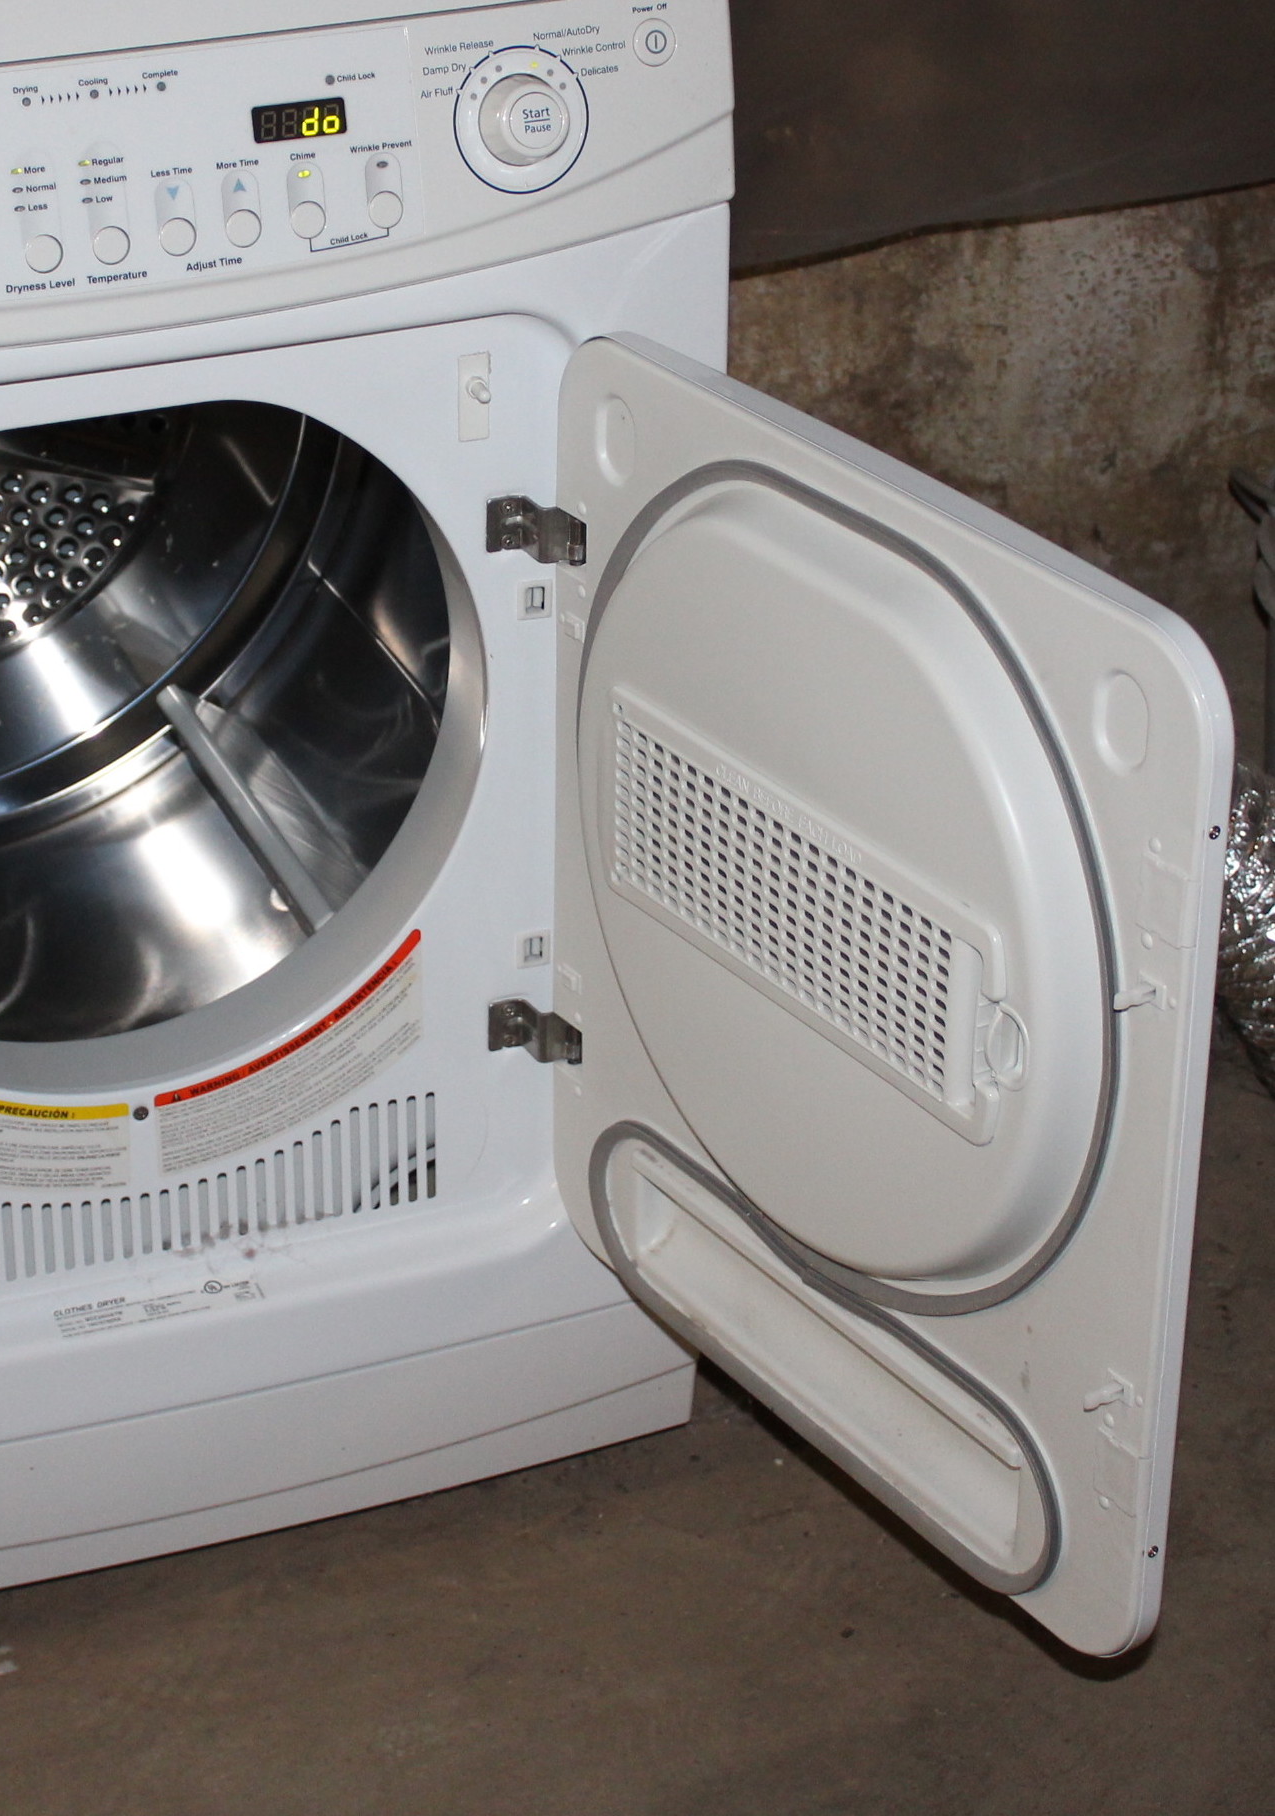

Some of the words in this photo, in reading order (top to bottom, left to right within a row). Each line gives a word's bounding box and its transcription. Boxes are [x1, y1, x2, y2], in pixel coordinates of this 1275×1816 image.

[632, 4, 653, 14] Power
[656, 2, 668, 11] Off
[533, 25, 601, 41] Normal/AutoDry
[424, 44, 458, 56] Wrinkle
[459, 39, 494, 53] Release
[562, 44, 595, 57] Wrinkle
[596, 40, 626, 53] Control
[142, 69, 178, 80] Complete
[422, 65, 449, 77] Damp
[451, 62, 467, 74] Dry
[580, 64, 619, 78] Delicates
[78, 77, 108, 87] Cooling
[337, 75, 356, 83] Child
[358, 72, 375, 81] Lock
[12, 85, 38, 95] Drying
[421, 88, 432, 100] Air
[434, 86, 454, 98] Fluff
[522, 107, 550, 120] Start
[302, 106, 340, 136] do
[524, 123, 552, 134] Pause
[350, 144, 380, 154] Wrinkle
[382, 140, 412, 151] Prevent
[91, 156, 124, 167] Regular
[290, 152, 316, 161] Chime
[24, 165, 46, 174] More
[216, 161, 237, 170] More
[239, 158, 259, 168] Time
[150, 169, 170, 178] Less
[172, 167, 193, 176] Time
[93, 175, 127, 185] Medium
[26, 183, 57, 193] Normal
[95, 195, 113, 203] Low
[28, 203, 48, 212] Less
[330, 236, 349, 246] Child
[351, 232, 368, 242] Lock
[186, 260, 217, 273] Adjust
[219, 256, 243, 268] Time
[87, 270, 148, 285] Temperature
[6, 282, 47, 295] Dryness
[50, 278, 75, 290] Level
[716, 764, 749, 792] CLEAN
[753, 786, 794, 820] BEFORE
[189, 1073, 240, 1097] WARNING
[247, 1022, 327, 1074] AVERTISSEMENT
[53, 1303, 93, 1317] CLOTHES
[97, 1297, 125, 1308] DRYER
